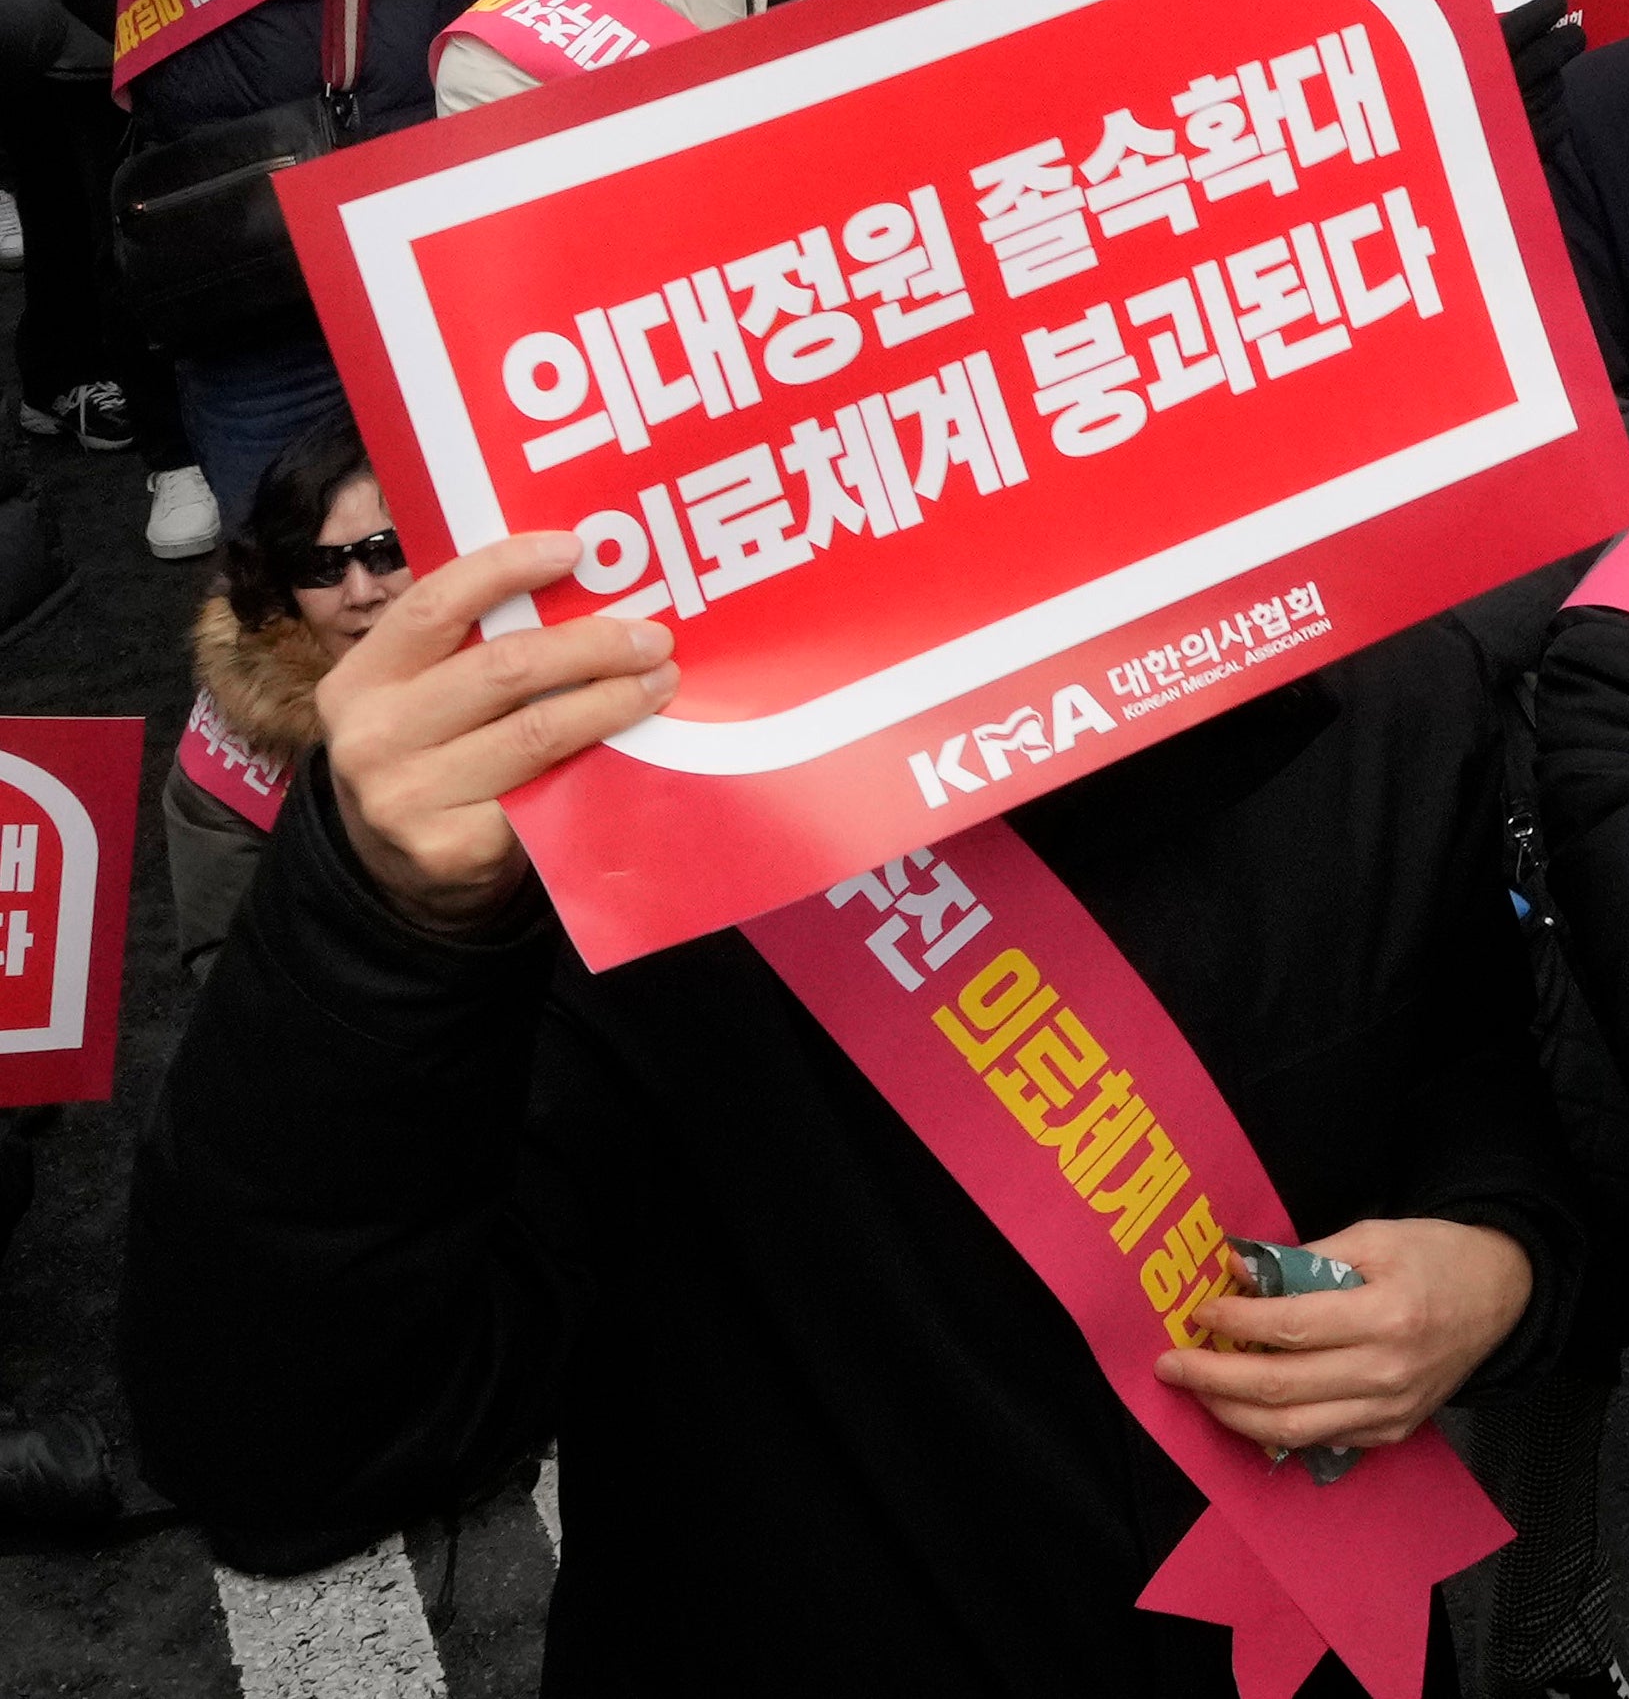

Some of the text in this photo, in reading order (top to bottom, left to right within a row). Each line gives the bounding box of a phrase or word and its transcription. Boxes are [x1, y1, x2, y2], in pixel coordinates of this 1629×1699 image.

[500, 21, 1401, 477] 의대정원 졸속확대
[569, 183, 1445, 624] 의료체계 붕괴된다
[907, 683, 1120, 810] KMA
[1105, 579, 1328, 700] 대한의사협회
[930, 946, 1195, 1254] 의료체계
